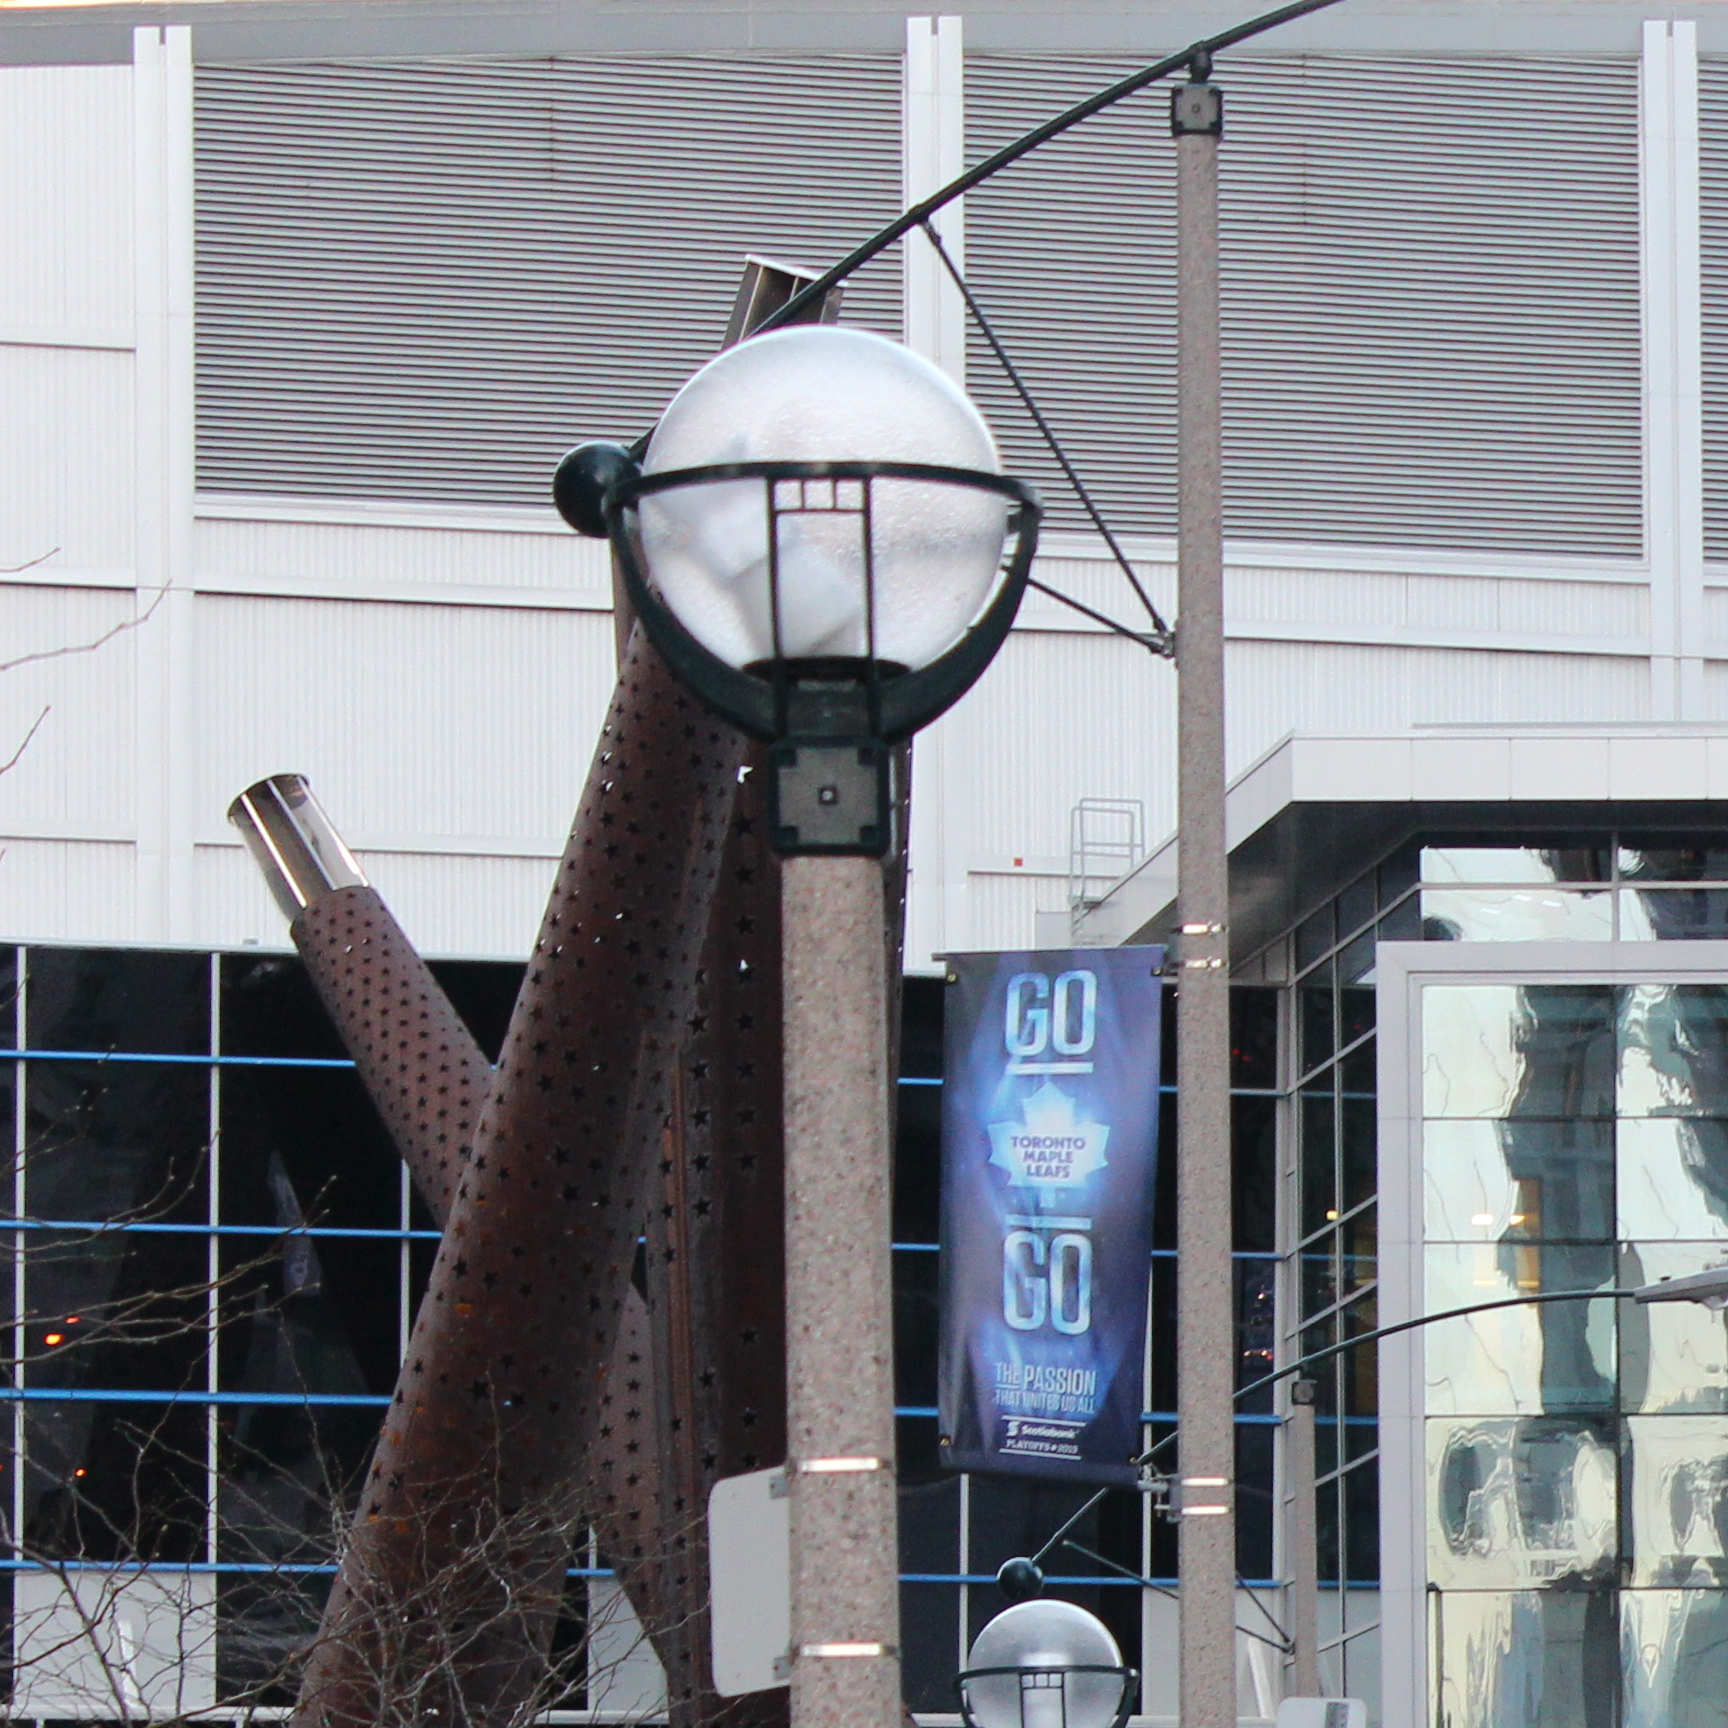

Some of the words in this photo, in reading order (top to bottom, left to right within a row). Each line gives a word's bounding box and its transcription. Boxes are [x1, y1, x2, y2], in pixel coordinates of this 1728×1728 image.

[1005, 969, 1097, 1057] GO
[1012, 1135, 1087, 1151] TORONTO
[1023, 1149, 1075, 1164] MAPLE
[1026, 1163, 1071, 1179] LEAFS
[1003, 1230, 1093, 1336] GO
[994, 1361, 1020, 1385] THE
[1023, 1364, 1097, 1397] PASSION
[994, 1388, 1020, 1408] THAT
[1076, 1395, 1096, 1415] ALL
